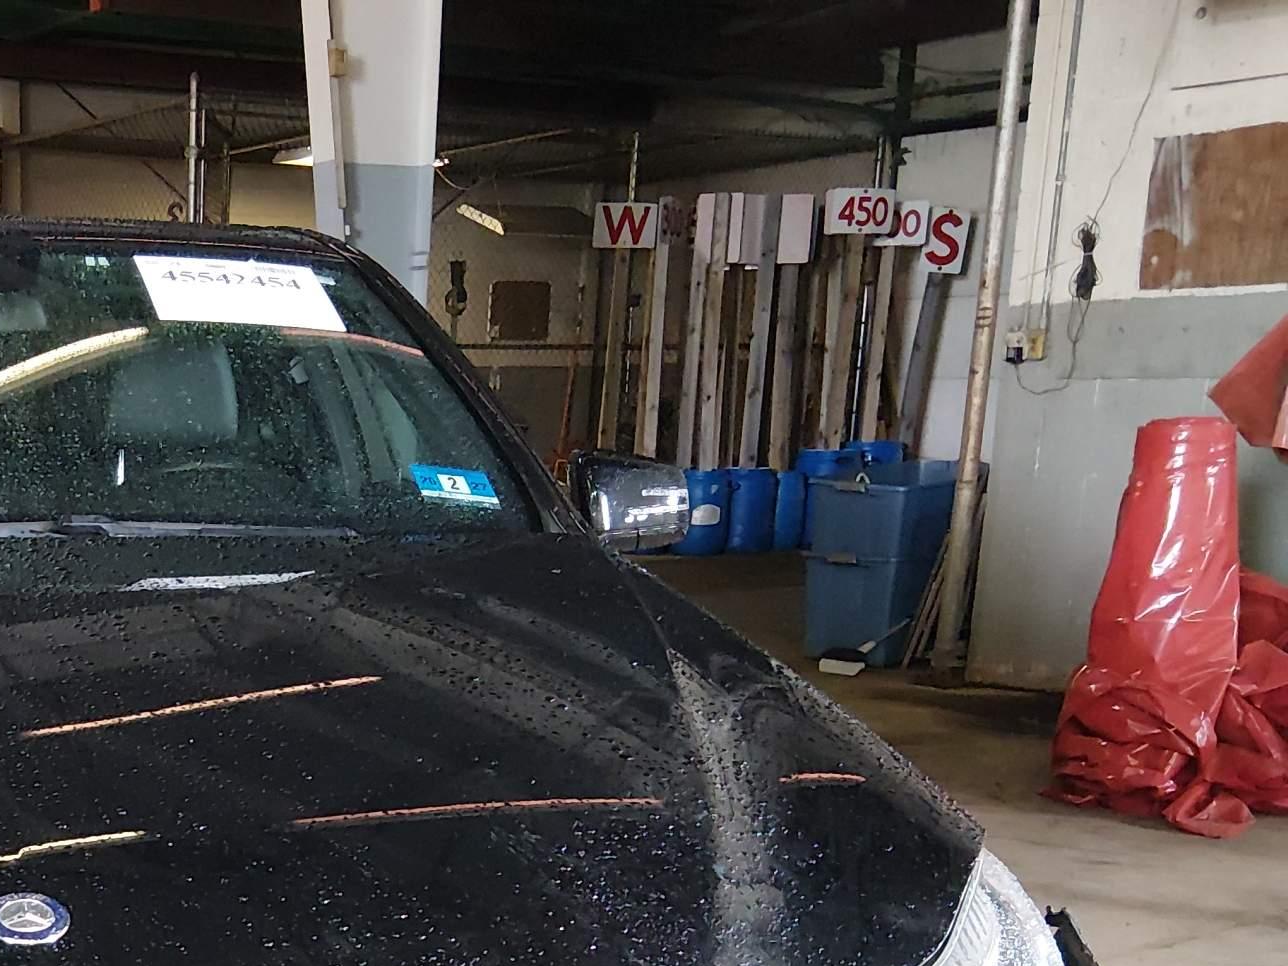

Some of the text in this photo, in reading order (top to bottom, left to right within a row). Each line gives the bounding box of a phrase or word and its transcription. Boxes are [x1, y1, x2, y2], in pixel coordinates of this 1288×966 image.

[602, 205, 651, 245] W
[838, 196, 889, 227] 450
[925, 212, 963, 265] S
[447, 477, 460, 490] 2
